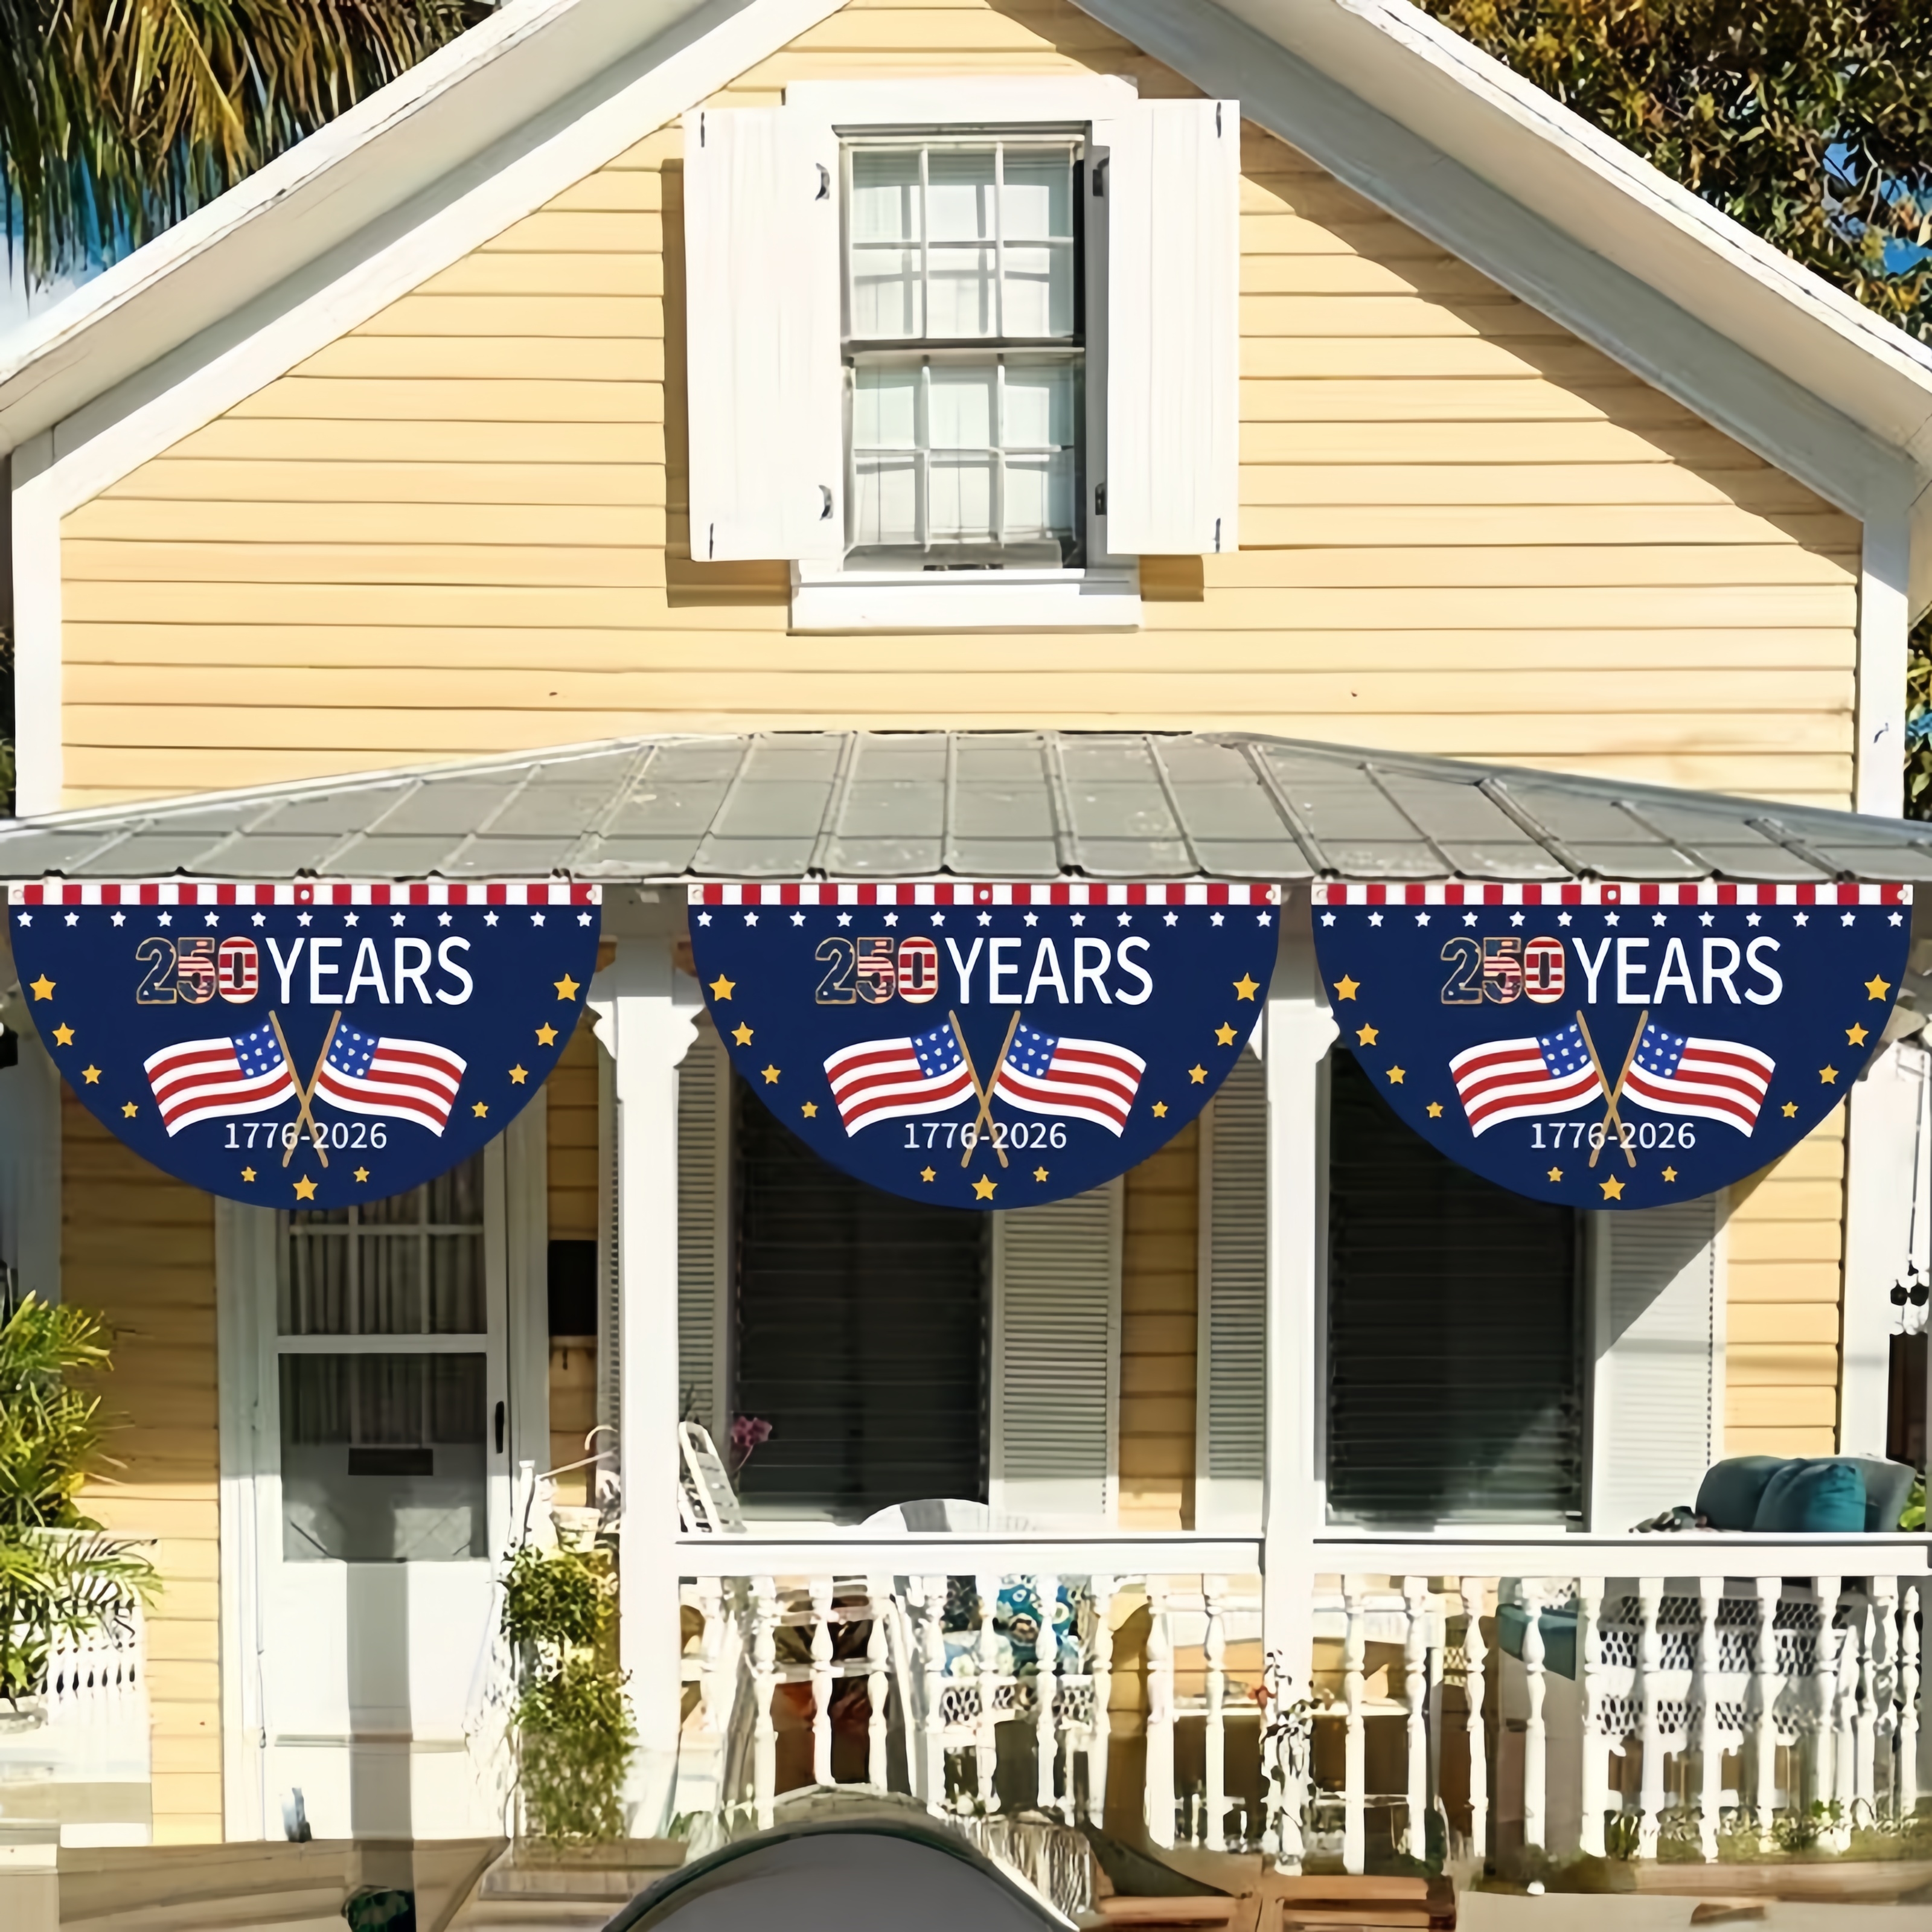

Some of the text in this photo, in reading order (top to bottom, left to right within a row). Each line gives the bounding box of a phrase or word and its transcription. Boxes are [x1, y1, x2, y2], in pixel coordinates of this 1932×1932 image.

[135, 936, 474, 1005] 250 YEARS
[815, 936, 1153, 1005] 250 YEARS
[1440, 936, 1783, 1005] 250 YEARS
[224, 1122, 387, 1149] 1776-2026
[904, 1122, 1067, 1149] 1776-2026
[1531, 1122, 1696, 1149] 1776-2026
